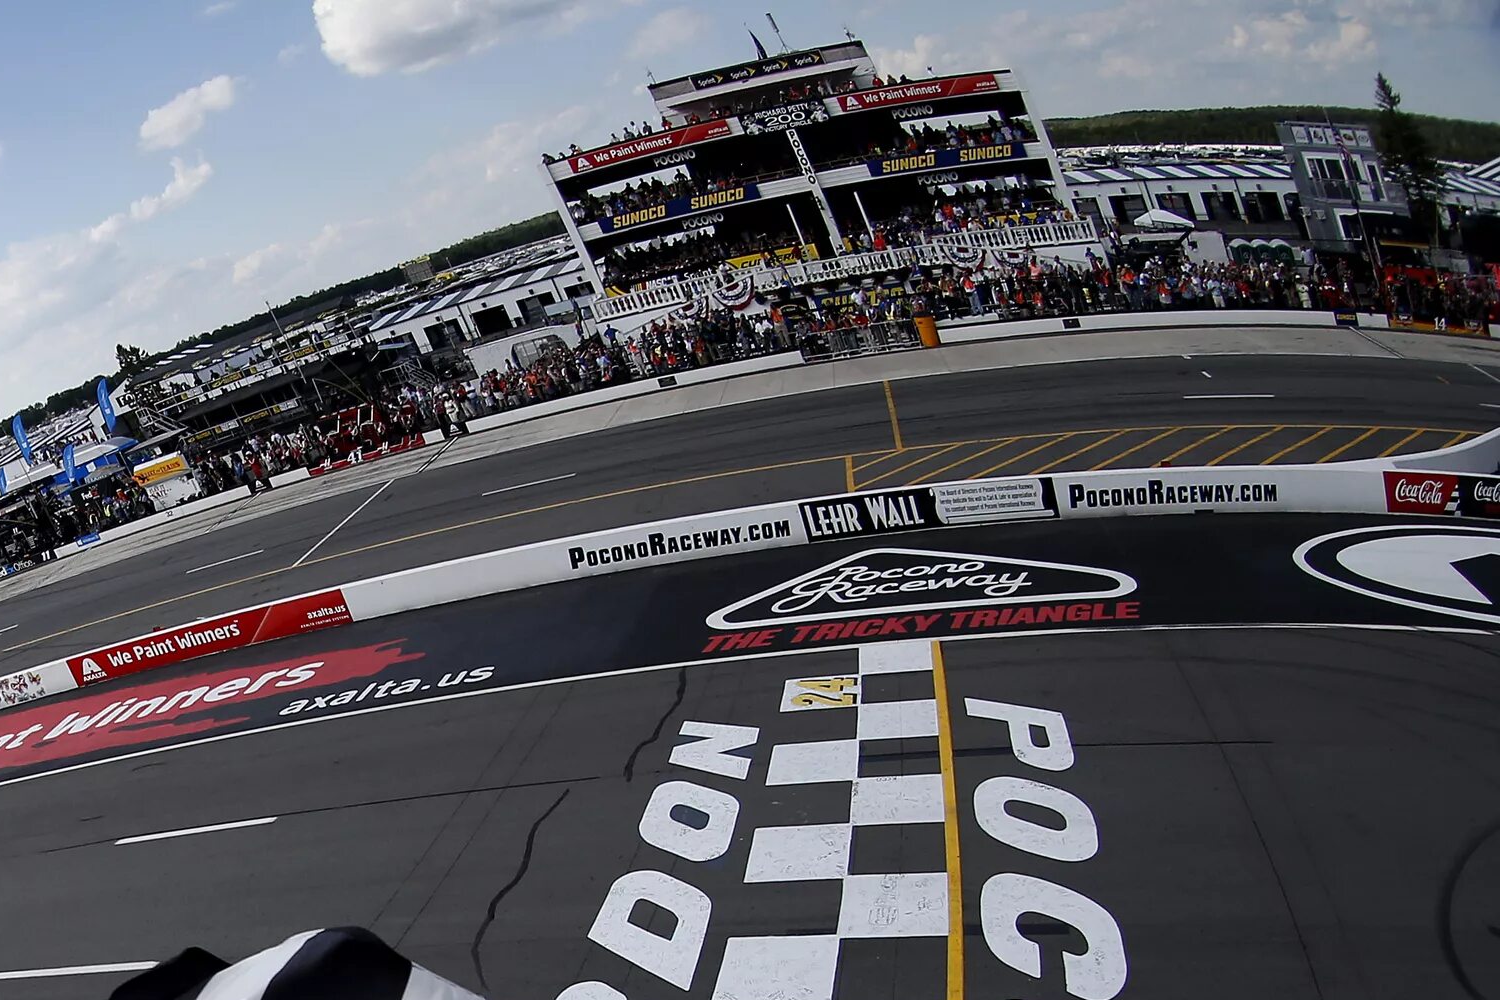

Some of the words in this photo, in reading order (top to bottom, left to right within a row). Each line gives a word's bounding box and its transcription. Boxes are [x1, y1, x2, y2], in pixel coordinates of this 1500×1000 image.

[698, 77, 715, 87] Sprint
[730, 70, 748, 79] Sprint
[763, 62, 781, 72] Sprint
[795, 56, 813, 66] Sprint
[863, 92, 879, 103] We
[879, 87, 904, 101] Paint
[903, 83, 942, 97] Winners
[754, 105, 787, 119] RICHARD
[787, 102, 809, 115] PETTY
[765, 111, 806, 127] 200
[891, 104, 934, 120] POCONO
[763, 124, 788, 133] VICTORY
[790, 119, 812, 128] CIRCLE
[593, 151, 609, 163] We
[611, 143, 635, 158] Paint
[634, 135, 673, 152] Winners
[653, 149, 696, 167] POCONO
[788, 130, 816, 185] POCONO
[882, 153, 935, 174] SUNOCO
[959, 144, 1012, 162] SUNOCO
[917, 171, 959, 186] POCONO
[613, 204, 666, 229] SUNOCO
[691, 187, 744, 210] SUNOCO
[681, 212, 724, 230] POCONO
[1433, 316, 1446, 331] 14
[347, 447, 363, 465] 41
[1395, 479, 1444, 504] Coca-Cola
[803, 503, 863, 538] LEHR
[863, 494, 925, 531] WALL
[41, 550, 50, 561] 11
[830, 561, 985, 582] Pocono
[772, 569, 1032, 614] Raceway
[306, 604, 346, 620] axalta.us
[701, 629, 776, 654] THE
[790, 614, 942, 645] TRICKY
[949, 602, 1141, 630] TRIANGLE
[107, 651, 133, 668] We
[134, 636, 175, 659] Paint
[176, 621, 240, 649] Winners
[278, 660, 494, 718] axalta.us
[791, 677, 858, 706] 24
[44, 661, 325, 742] Winners
